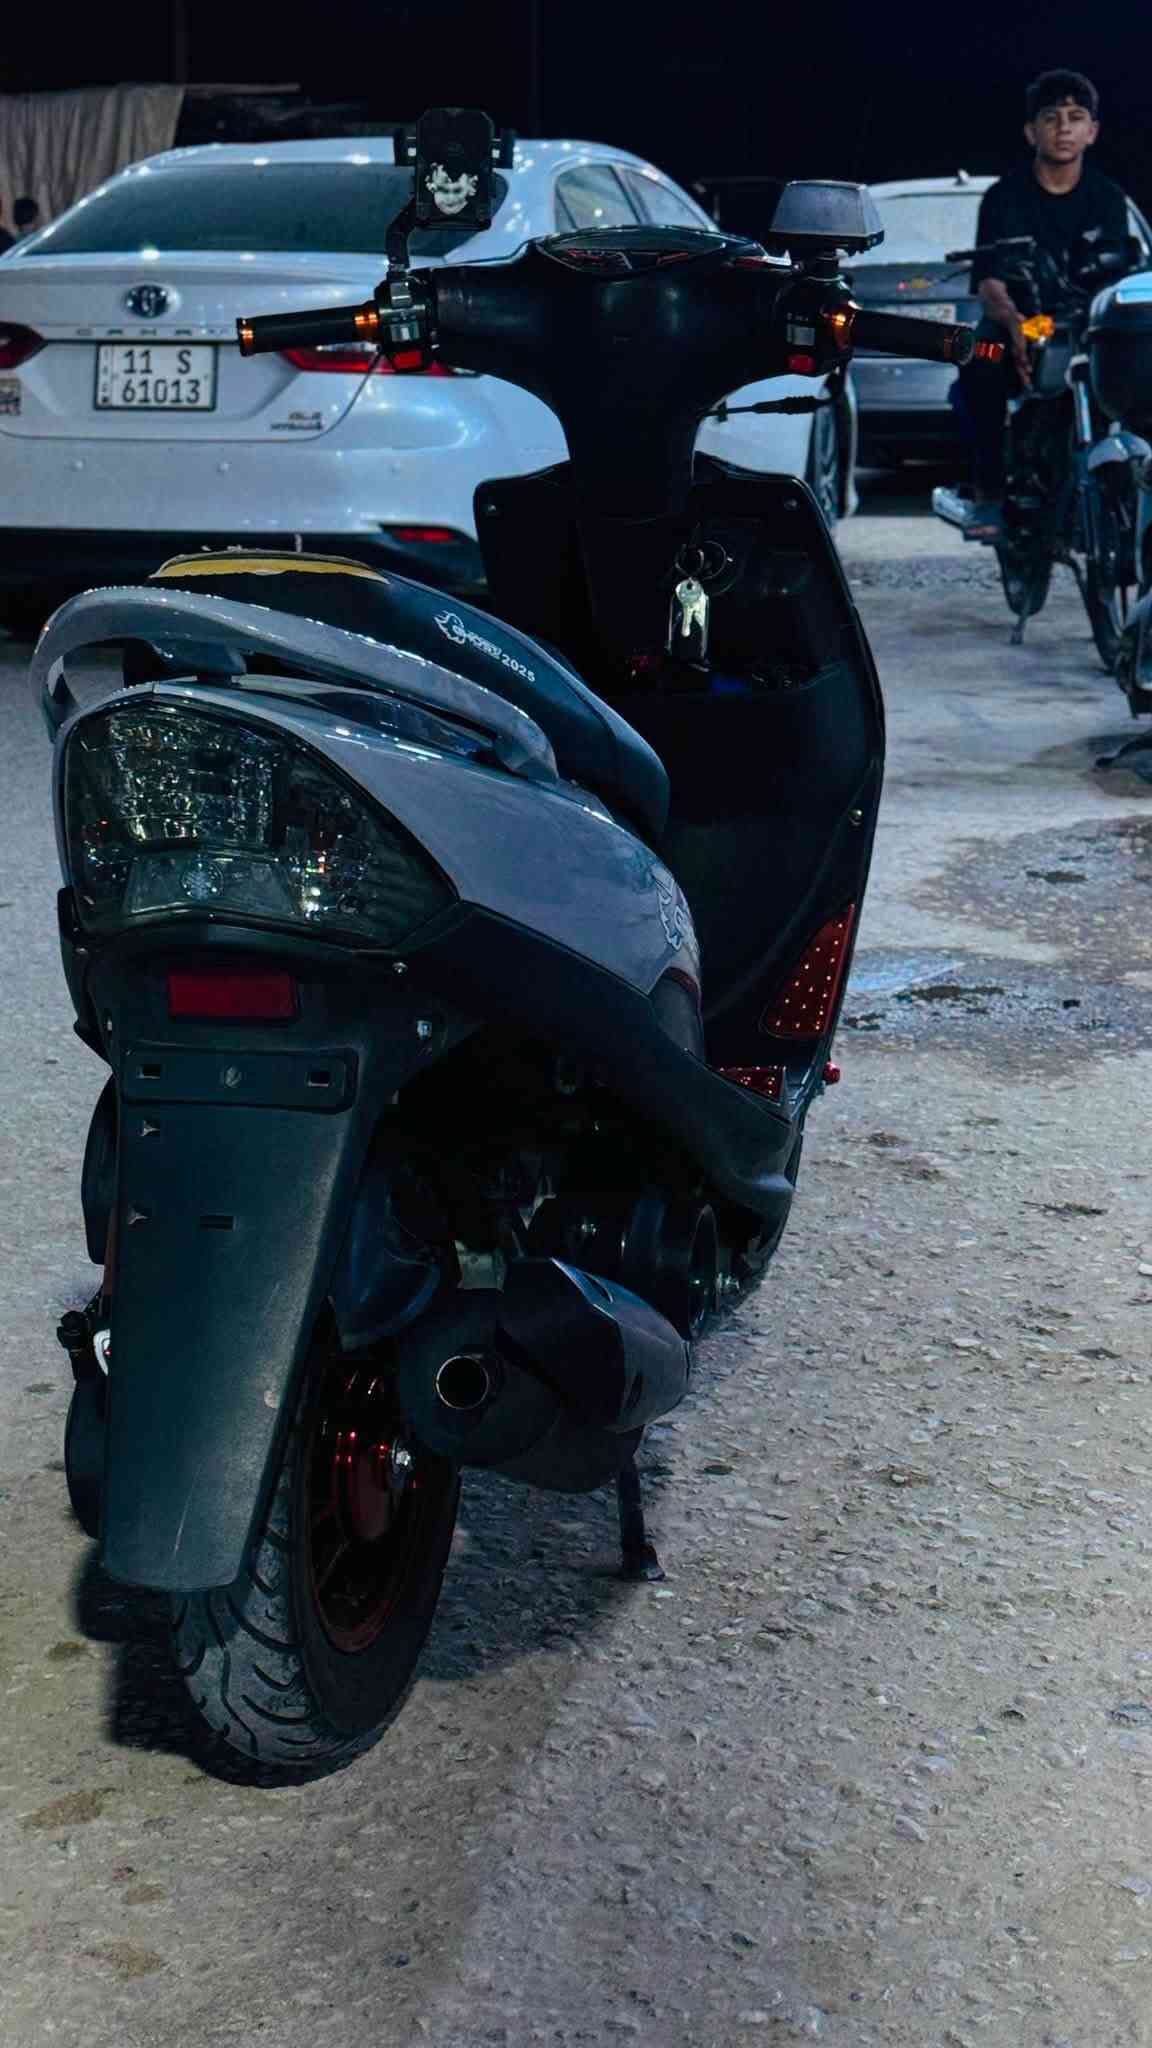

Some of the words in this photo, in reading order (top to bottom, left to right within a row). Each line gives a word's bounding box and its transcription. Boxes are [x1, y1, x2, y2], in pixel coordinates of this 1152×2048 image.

[123, 349, 153, 374] 11
[176, 349, 193, 375] S
[121, 378, 201, 404] 61013
